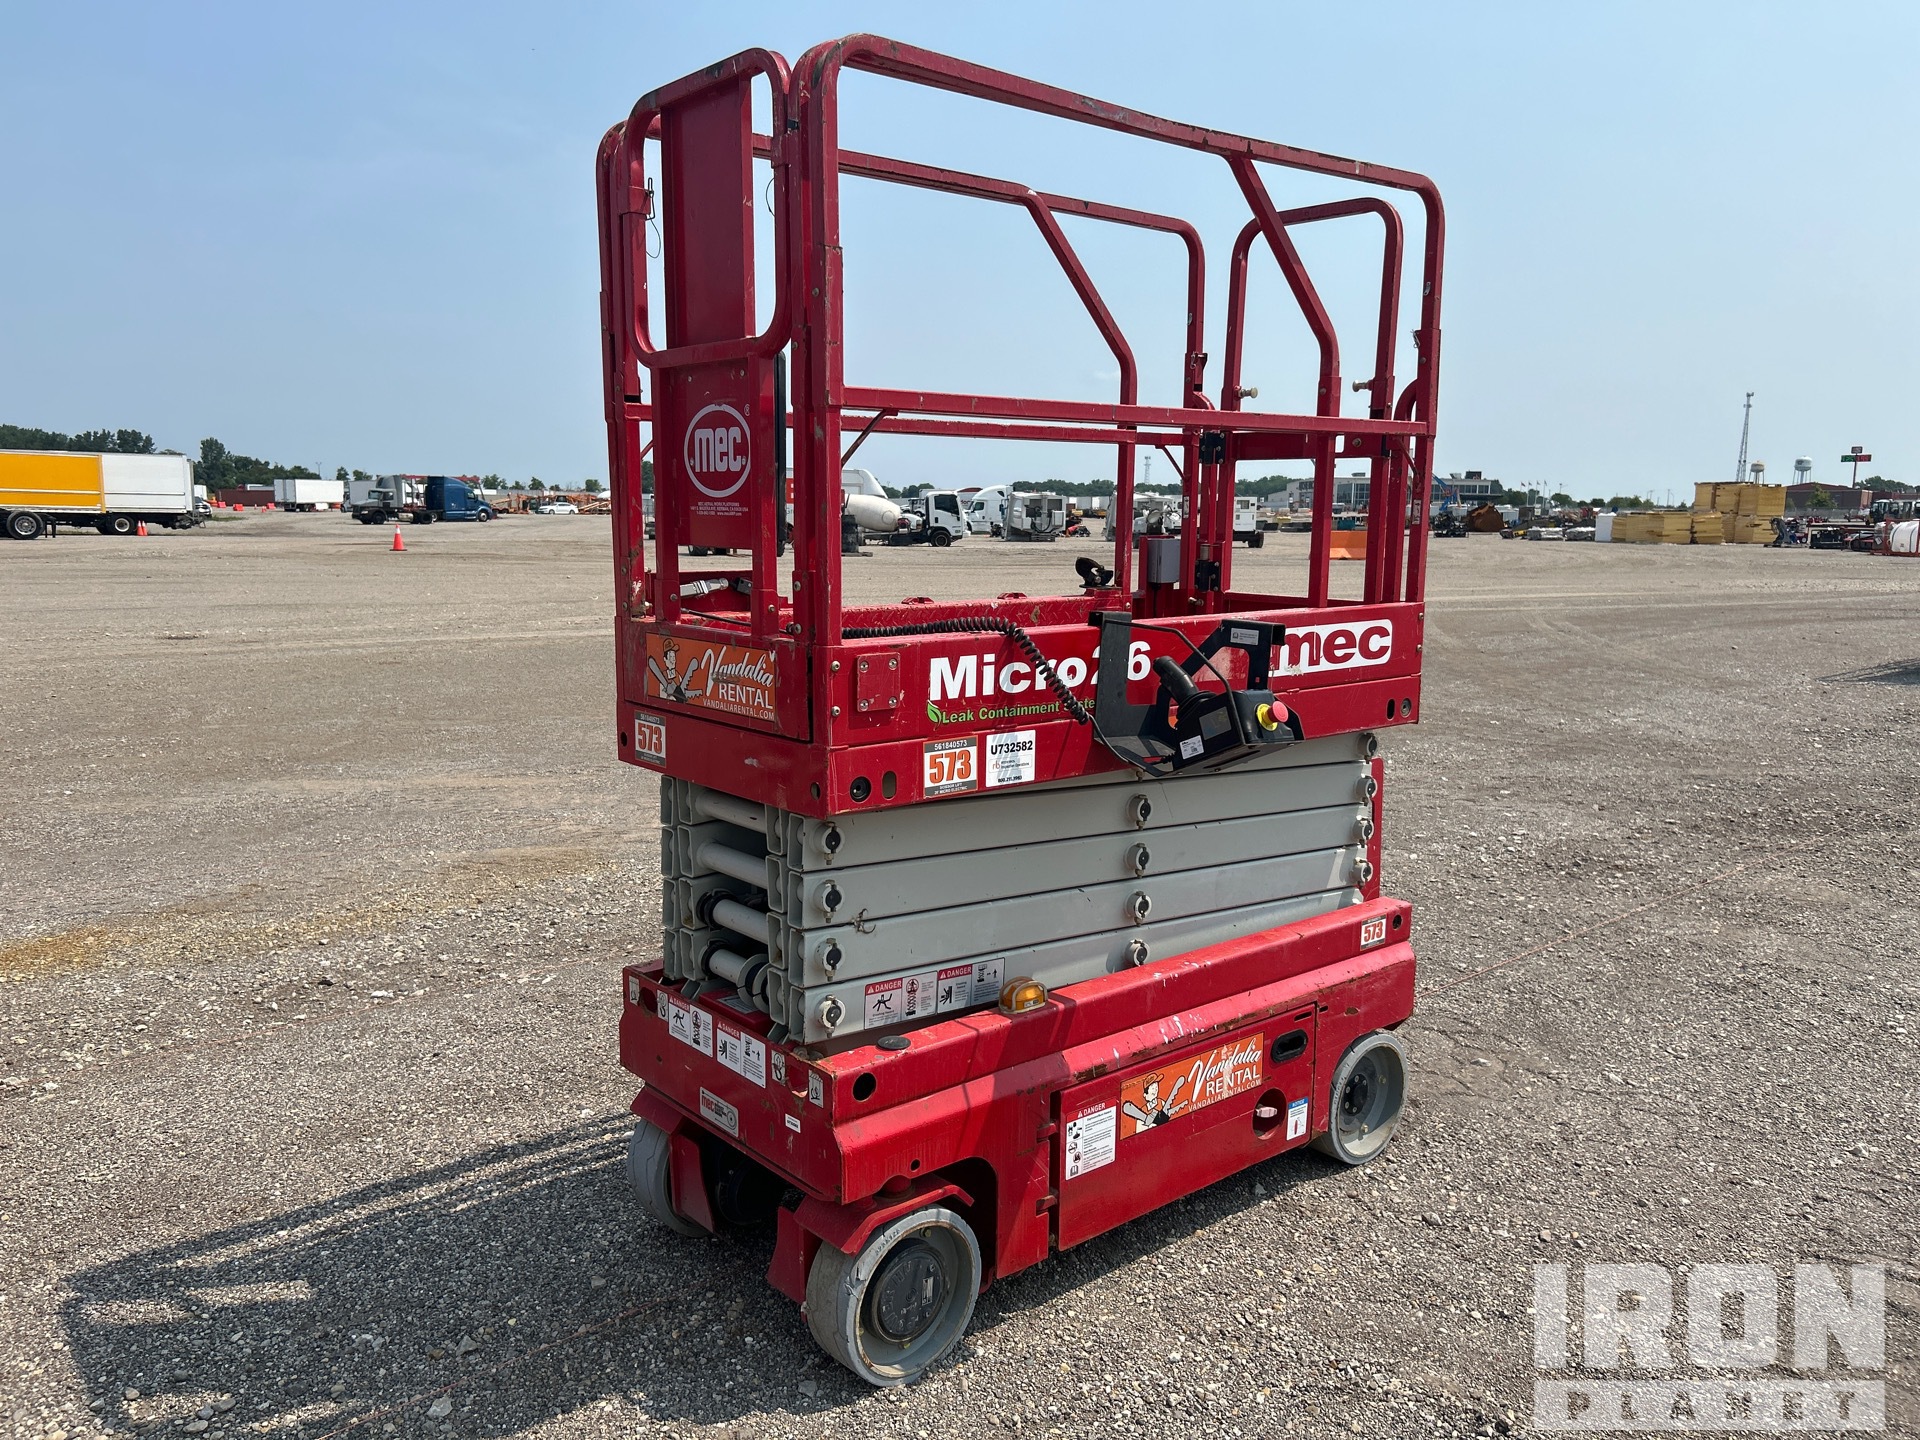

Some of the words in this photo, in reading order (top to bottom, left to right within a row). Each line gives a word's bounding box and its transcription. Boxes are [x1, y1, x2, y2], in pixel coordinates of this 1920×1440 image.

[701, 645, 774, 696] Vandalia
[930, 641, 1151, 700] Micro6
[719, 683, 773, 709] RENTAL
[703, 698, 774, 720] VANDALIARENTAL.COM
[942, 709, 974, 724] Leak
[979, 700, 1060, 720] Containment
[638, 722, 662, 754] 573
[934, 740, 968, 751] 561840573
[991, 740, 1033, 755] U732582
[929, 749, 971, 785] 573
[1363, 921, 1383, 942] 573
[947, 966, 972, 977] DANGER
[875, 980, 902, 992] DANGER
[722, 1023, 740, 1038] DANGER
[1188, 1037, 1262, 1102] Vandalia
[1206, 1065, 1260, 1097] RENTAL
[1083, 1102, 1106, 1116] DANGER
